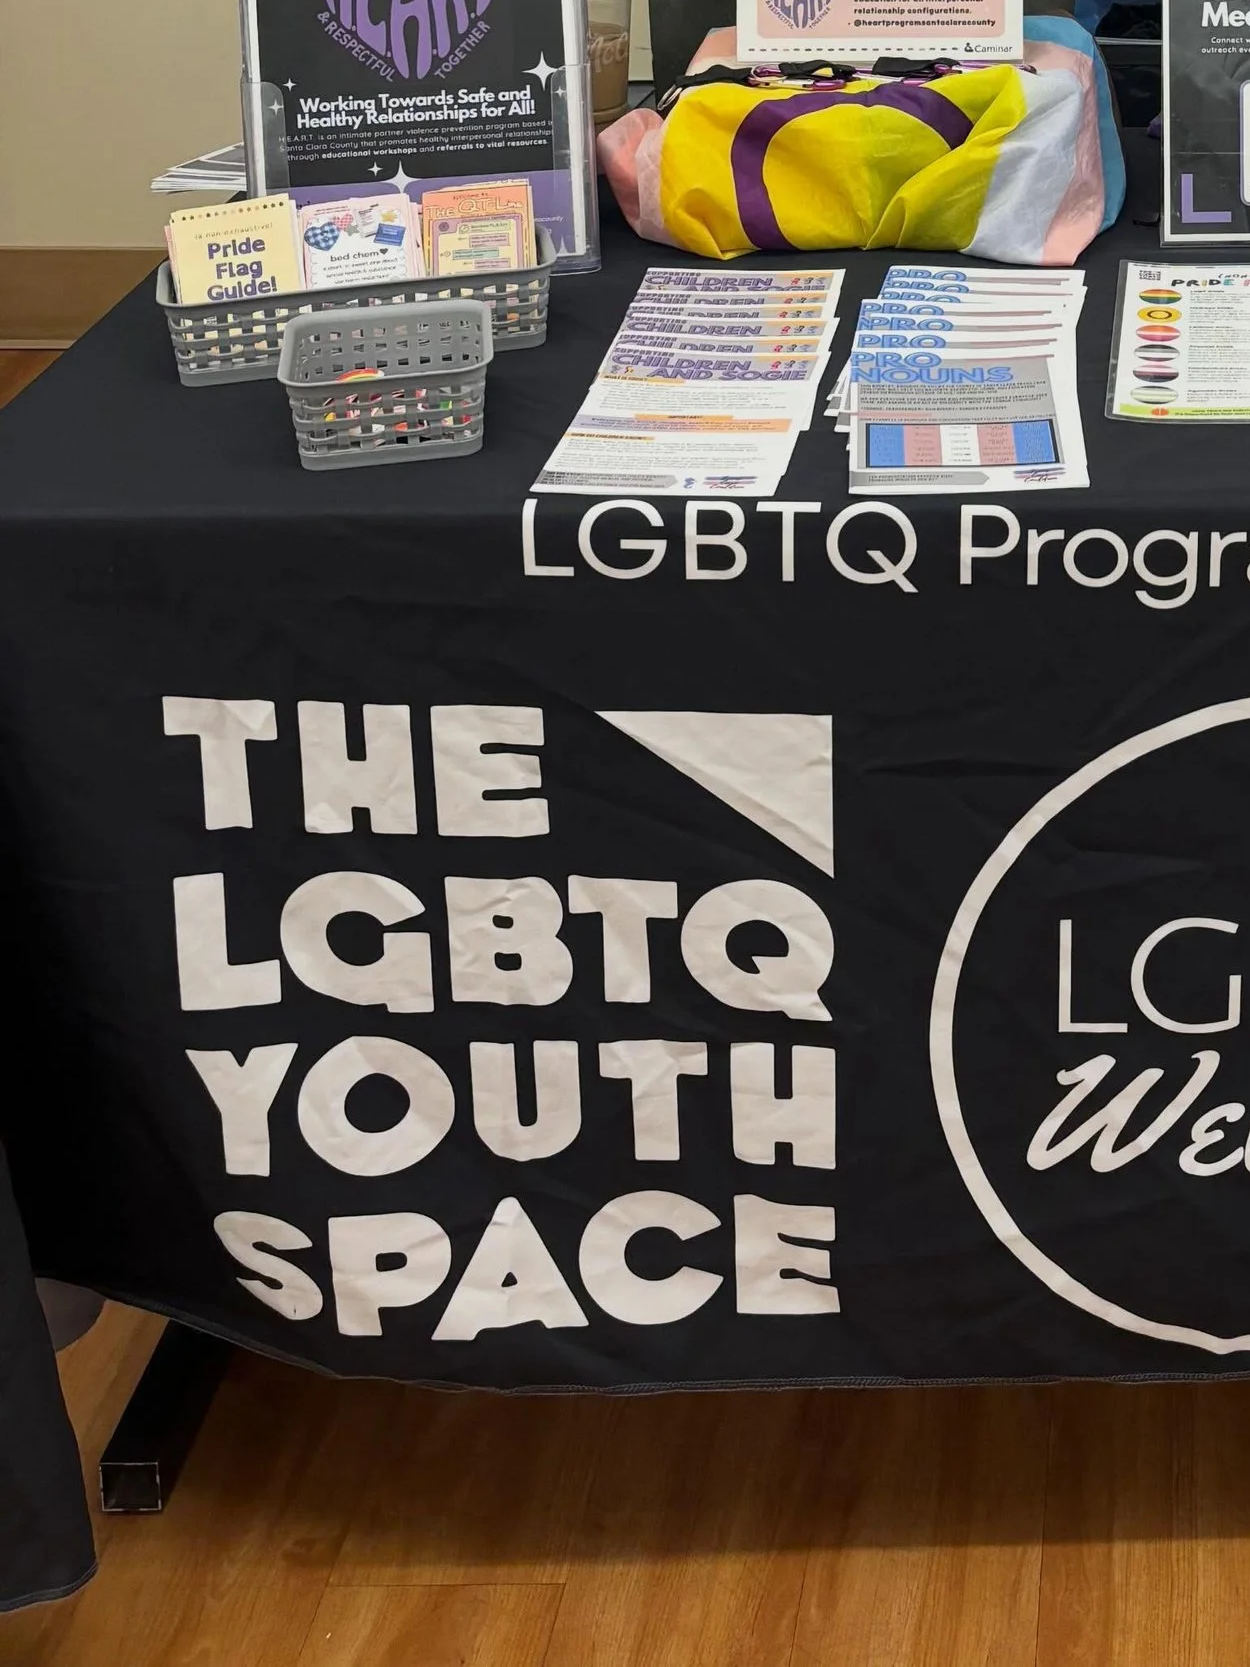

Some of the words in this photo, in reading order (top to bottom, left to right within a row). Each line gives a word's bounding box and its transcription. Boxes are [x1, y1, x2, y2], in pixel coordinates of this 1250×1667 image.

[317, 12, 329, 24] &
[324, 21, 401, 82] RESPECTFUL
[435, 21, 490, 79] TOGETHER
[975, 44, 1012, 54] Caminar
[300, 96, 375, 115] Working
[378, 90, 454, 108] Towards
[457, 87, 495, 104] Safe
[498, 85, 531, 100] and
[297, 111, 362, 130] Healthy
[367, 104, 477, 125] Relationships
[480, 103, 505, 117] for
[508, 100, 535, 115] All!
[207, 238, 266, 260] Pride
[216, 257, 263, 280] Flag
[207, 277, 277, 302] Guide!
[1171, 278, 1234, 287] PRIDE
[612, 354, 752, 370] CHILDREN
[851, 351, 942, 368] PRO
[650, 367, 719, 380] AND
[719, 370, 808, 381] SOGIE
[851, 366, 1014, 384] NOUNS
[521, 500, 918, 592] LGBTQ
[162, 695, 551, 837] THE
[172, 871, 835, 1023] LGBTQ
[185, 1035, 837, 1178] YOUTH
[212, 1190, 841, 1342] SPACE
